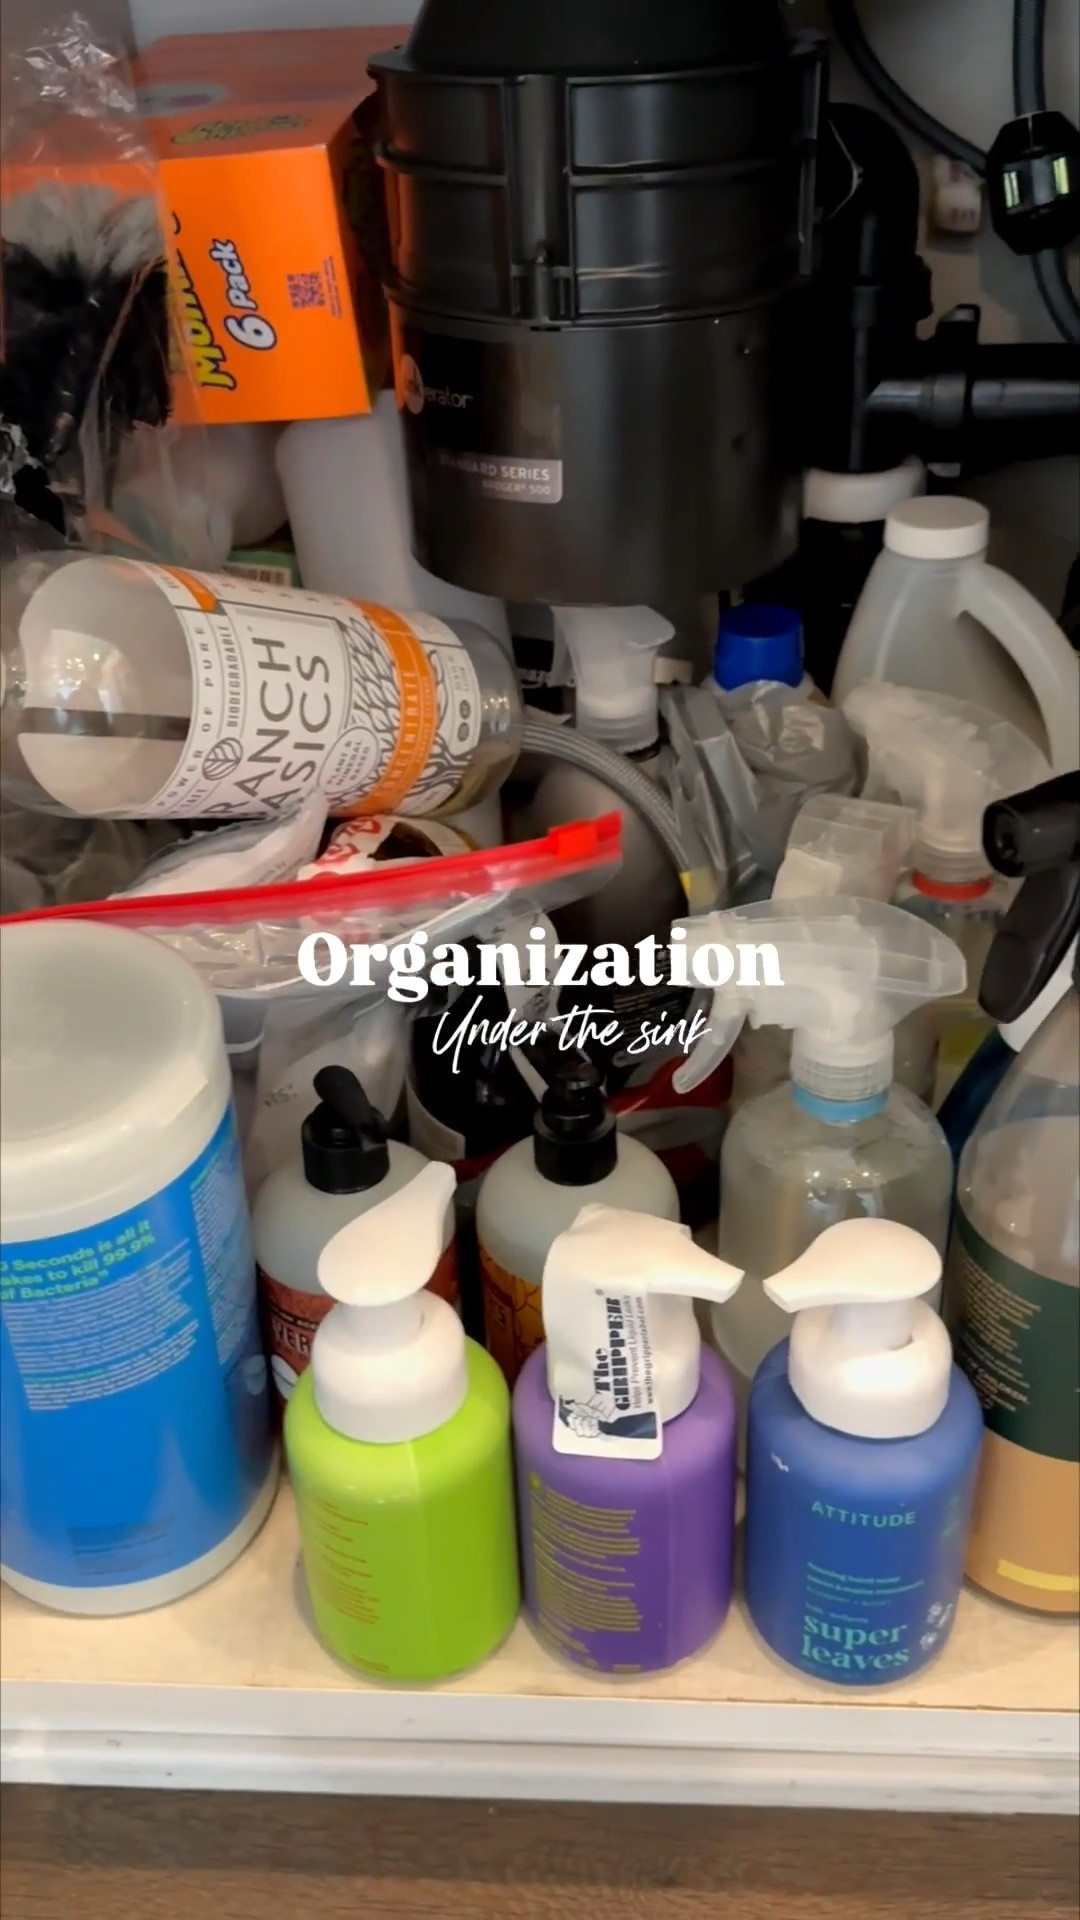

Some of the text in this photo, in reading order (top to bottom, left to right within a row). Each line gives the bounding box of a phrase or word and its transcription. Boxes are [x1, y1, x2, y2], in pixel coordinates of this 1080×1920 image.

[209, 238, 277, 351] 6 Pack
[501, 466, 551, 481] SERIES
[217, 624, 241, 728] BIODEGRADABLE
[156, 626, 215, 807] POWER OF PURE
[201, 636, 293, 815] RANCH
[255, 655, 332, 815] ASICS
[1, 1234, 156, 1287] akes to kill 99.9%
[12, 1247, 95, 1271] Seconds
[97, 1240, 112, 1252] is
[115, 1226, 135, 1245] all
[137, 1219, 150, 1233] it
[593, 1347, 611, 1395] The
[606, 1296, 631, 1411] GRIPPER
[628, 1345, 640, 1385] Prevent
[811, 1501, 917, 1529] ATTITUDE
[801, 1634, 910, 1670] leaves
[803, 1615, 908, 1650] super
